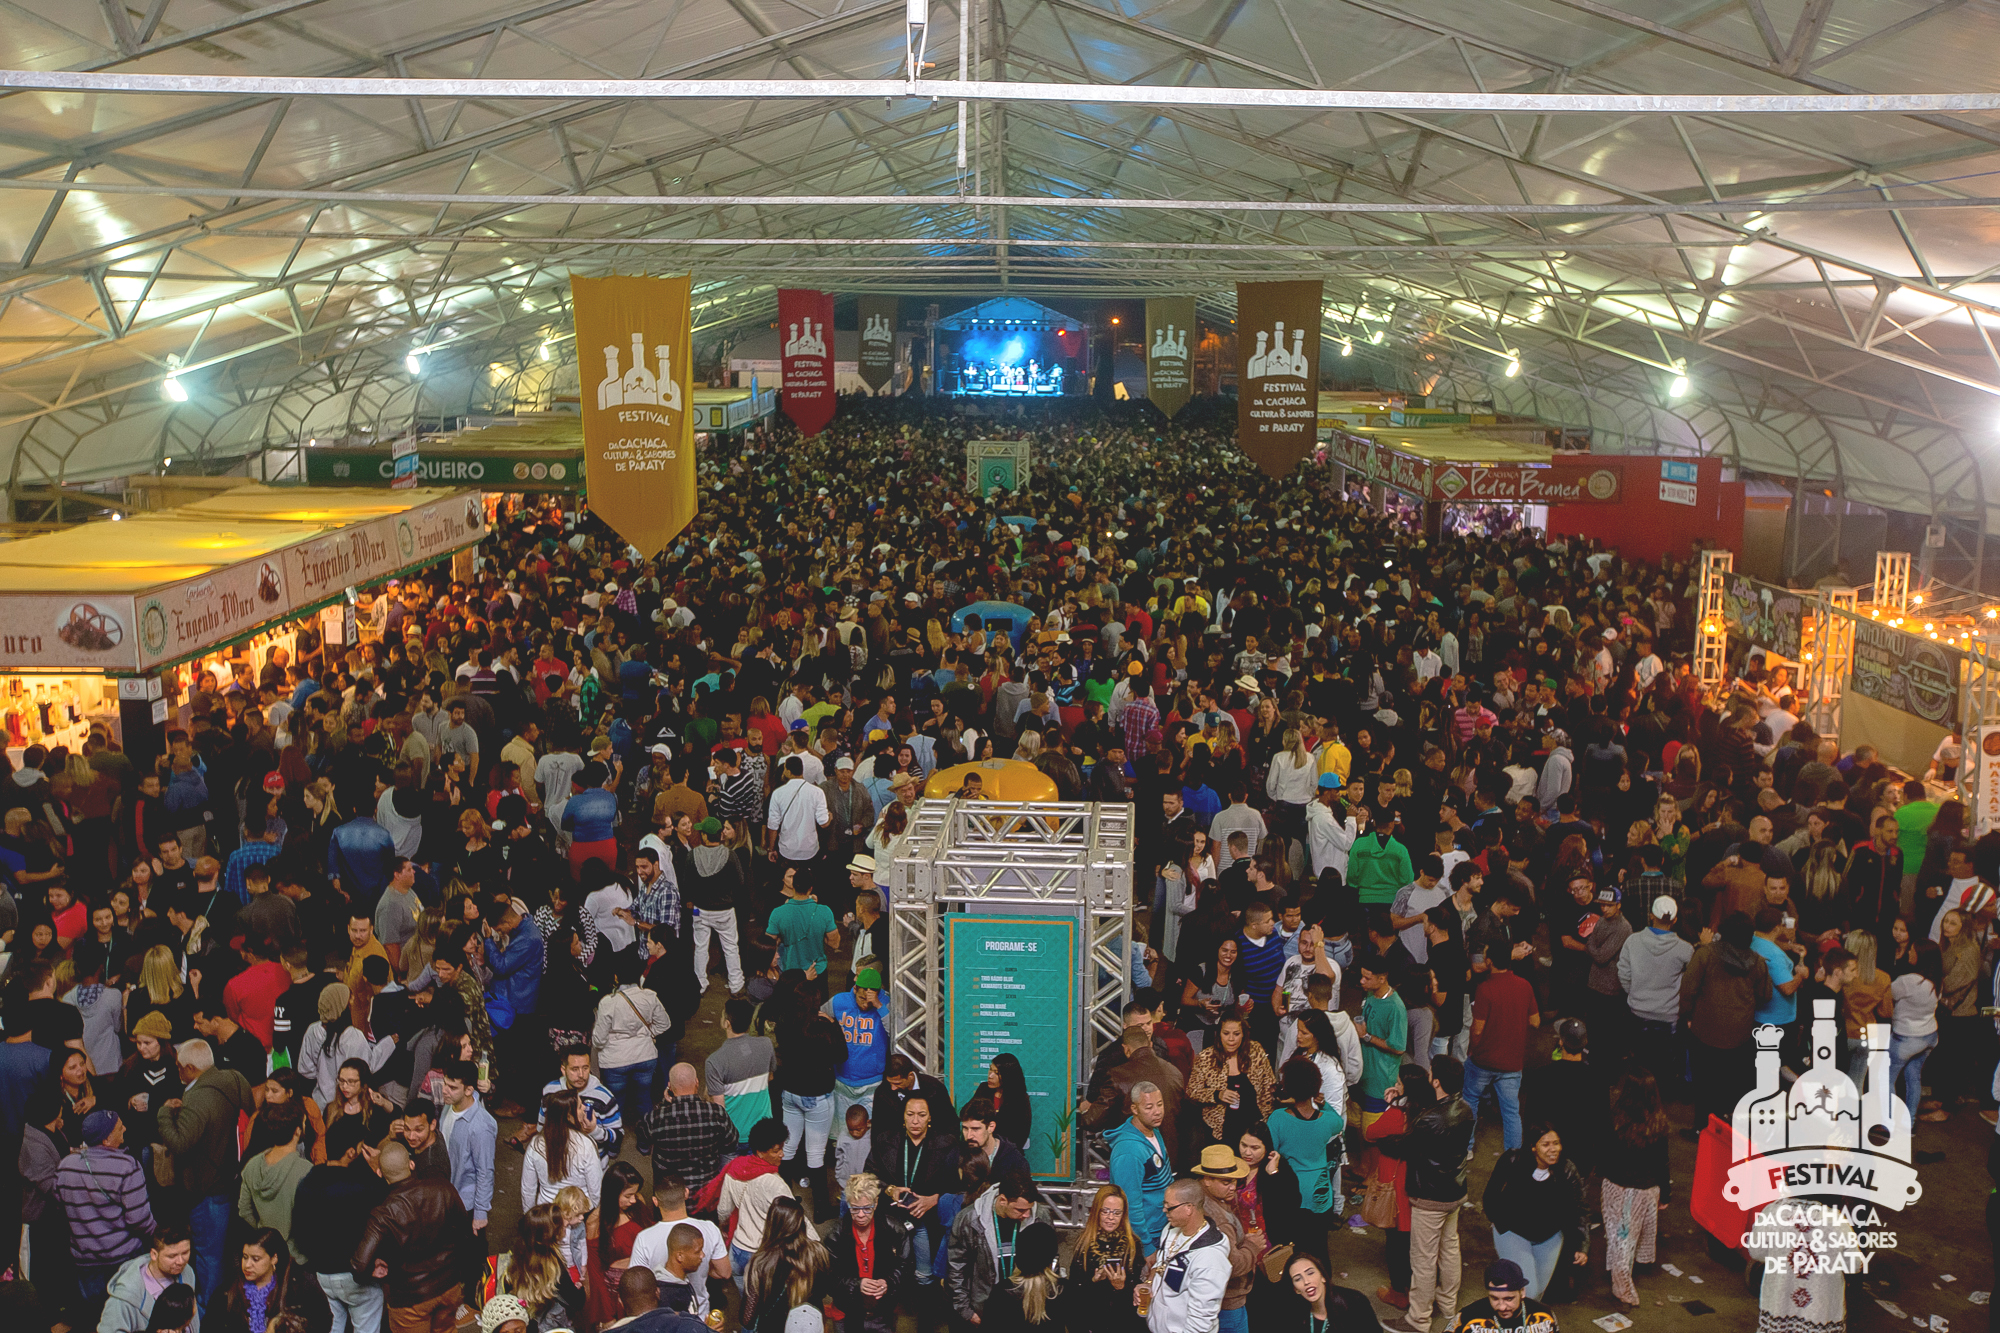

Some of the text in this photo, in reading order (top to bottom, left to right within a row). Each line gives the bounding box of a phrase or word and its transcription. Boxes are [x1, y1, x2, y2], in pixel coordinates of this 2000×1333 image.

[1263, 383, 1306, 392] FESTIVAL
[618, 410, 671, 426] FESTIVAL
[1250, 410, 1279, 418] CULTURA
[1280, 408, 1286, 418] &
[1287, 410, 1314, 418] SABORES
[1272, 423, 1304, 432] PARATY
[608, 442, 618, 450] DA
[603, 449, 677, 460] CULTURA & SABORES
[379, 460, 484, 479] CQUEIRO
[615, 460, 666, 471] DE PARATY
[1471, 468, 1580, 497] Pedra Branca
[295, 538, 350, 592] Engenho
[171, 604, 219, 645] Engenho
[985, 940, 1038, 952] PROGRAME-SE
[839, 1011, 874, 1029] John
[841, 1026, 873, 1045] ohn
